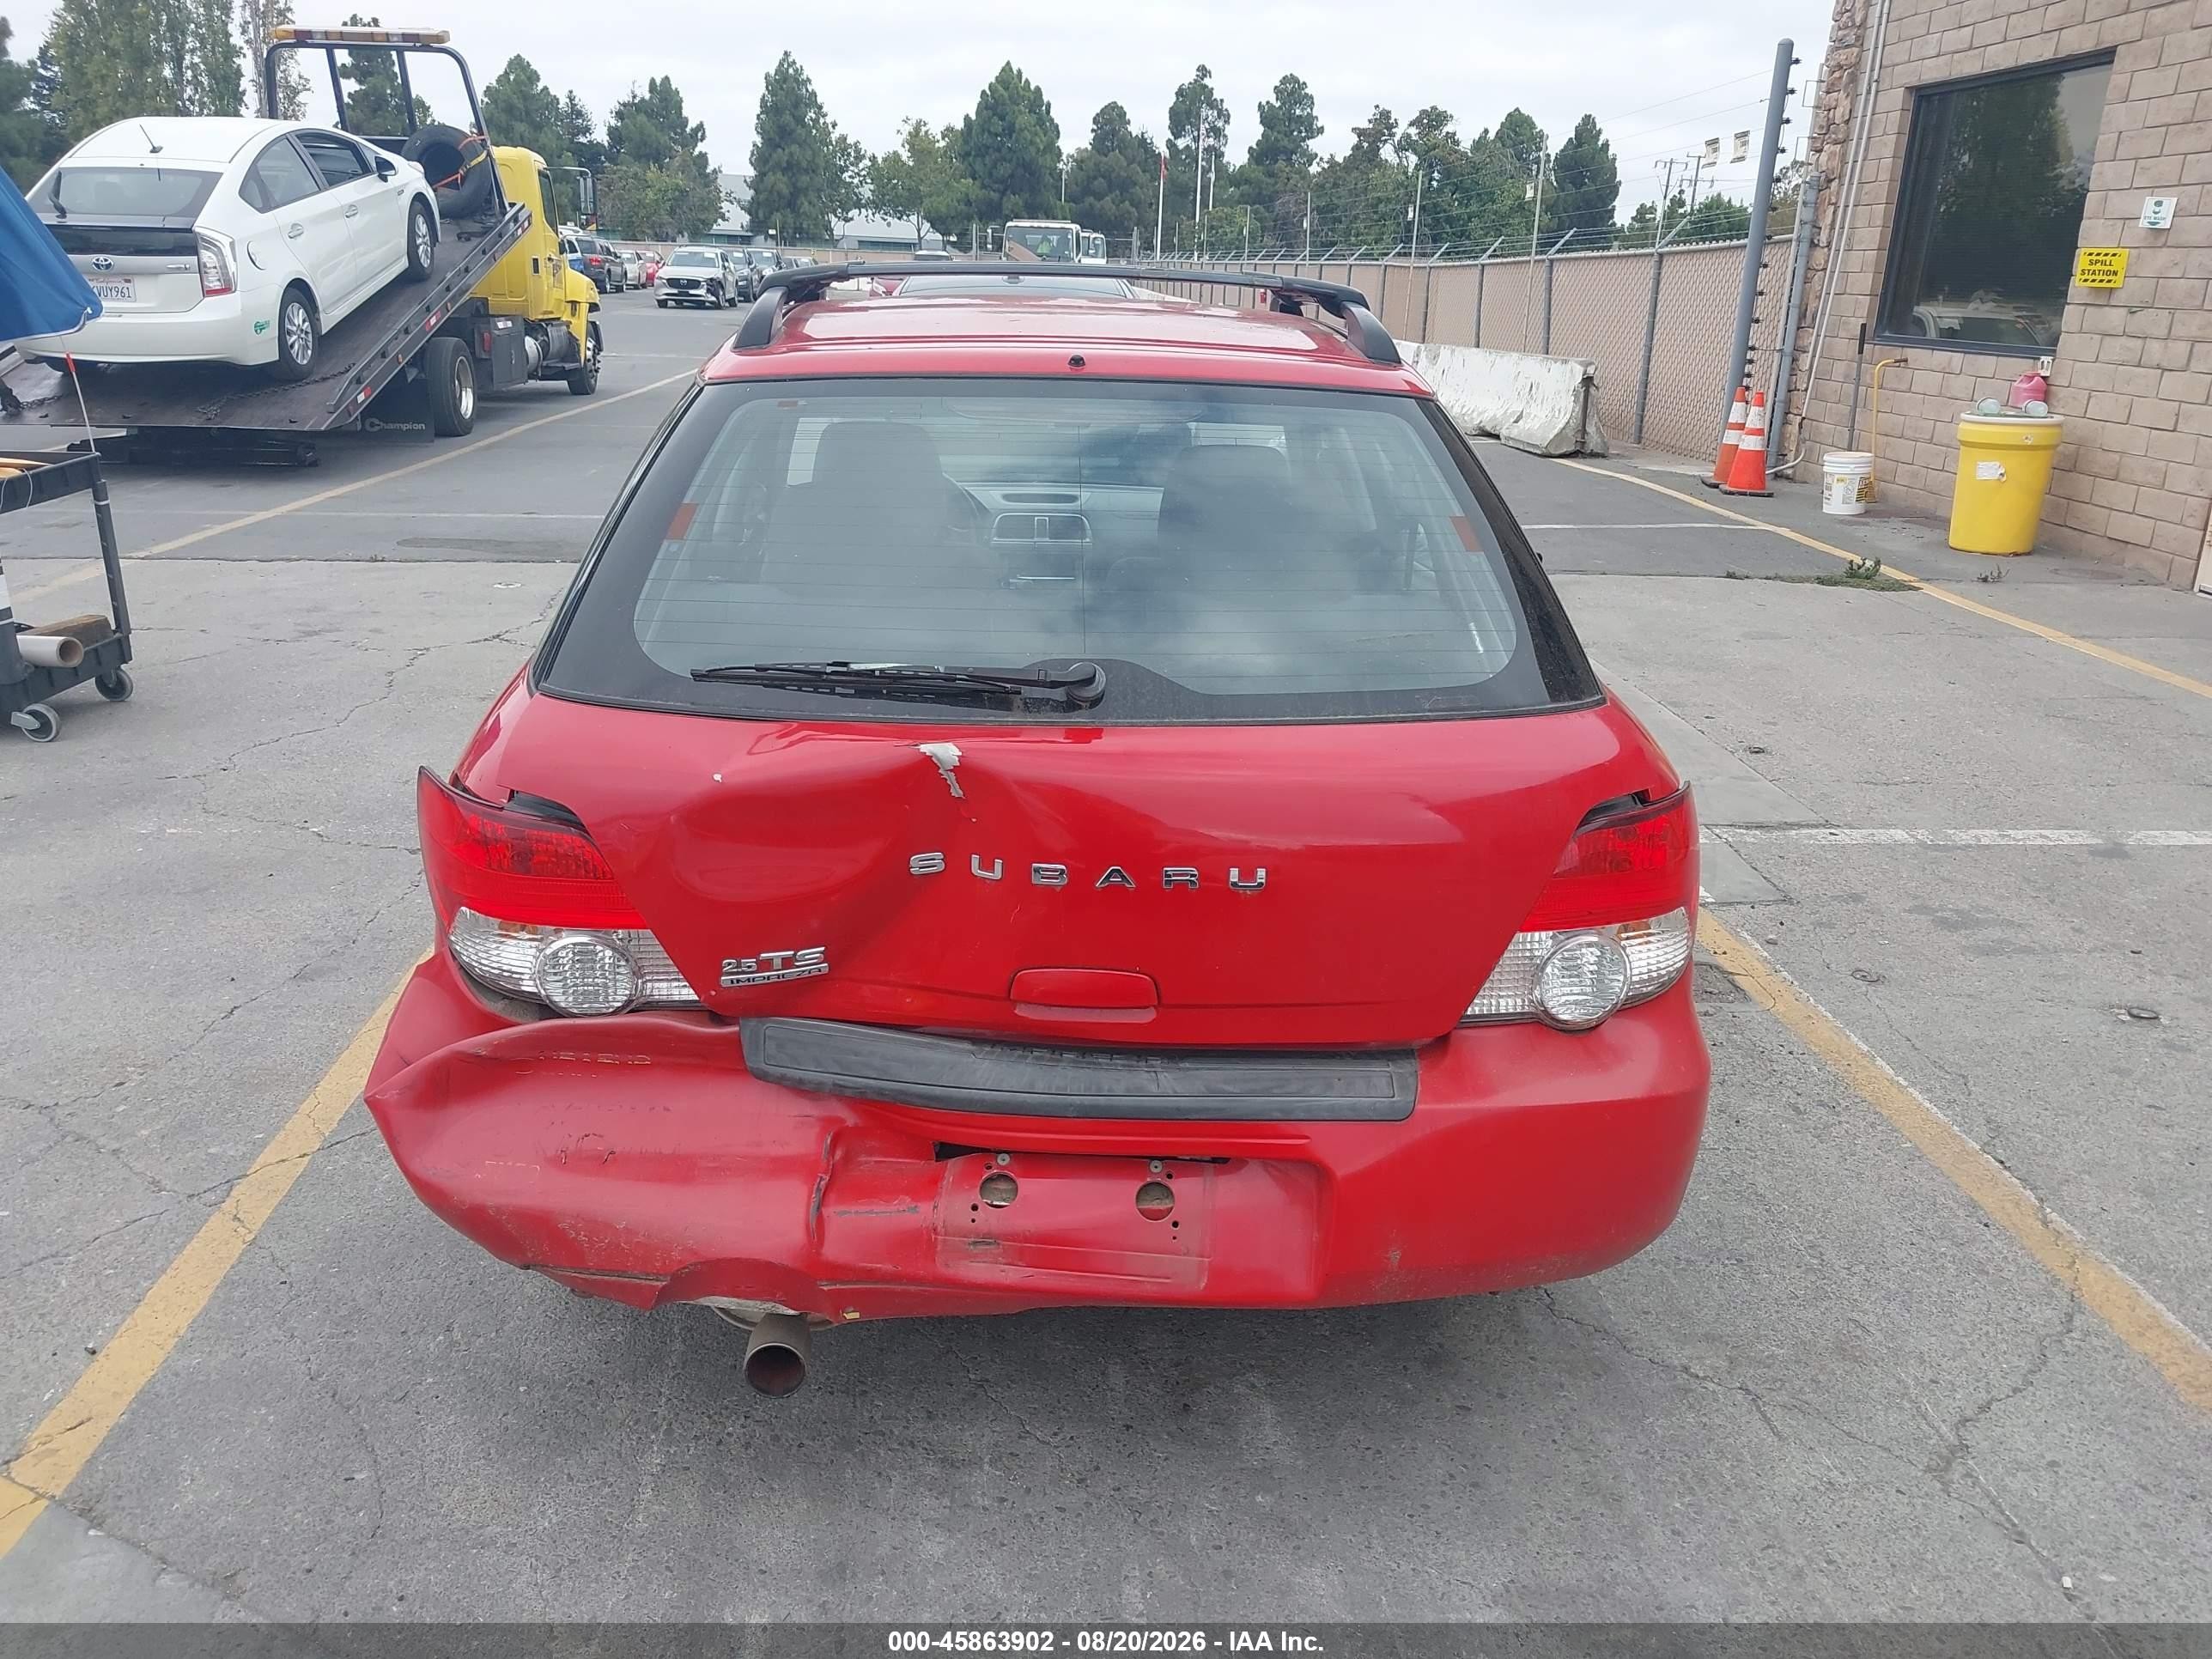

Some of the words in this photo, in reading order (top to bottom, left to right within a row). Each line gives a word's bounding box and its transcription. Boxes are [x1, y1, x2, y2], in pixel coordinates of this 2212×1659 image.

[2088, 258, 2114, 267] SPILL
[2081, 268, 2119, 276] STATION
[92, 285, 132, 298] VUY961
[364, 417, 426, 432] Champion
[909, 852, 1267, 891] SUBARU
[729, 968, 823, 985] IMPREZA
